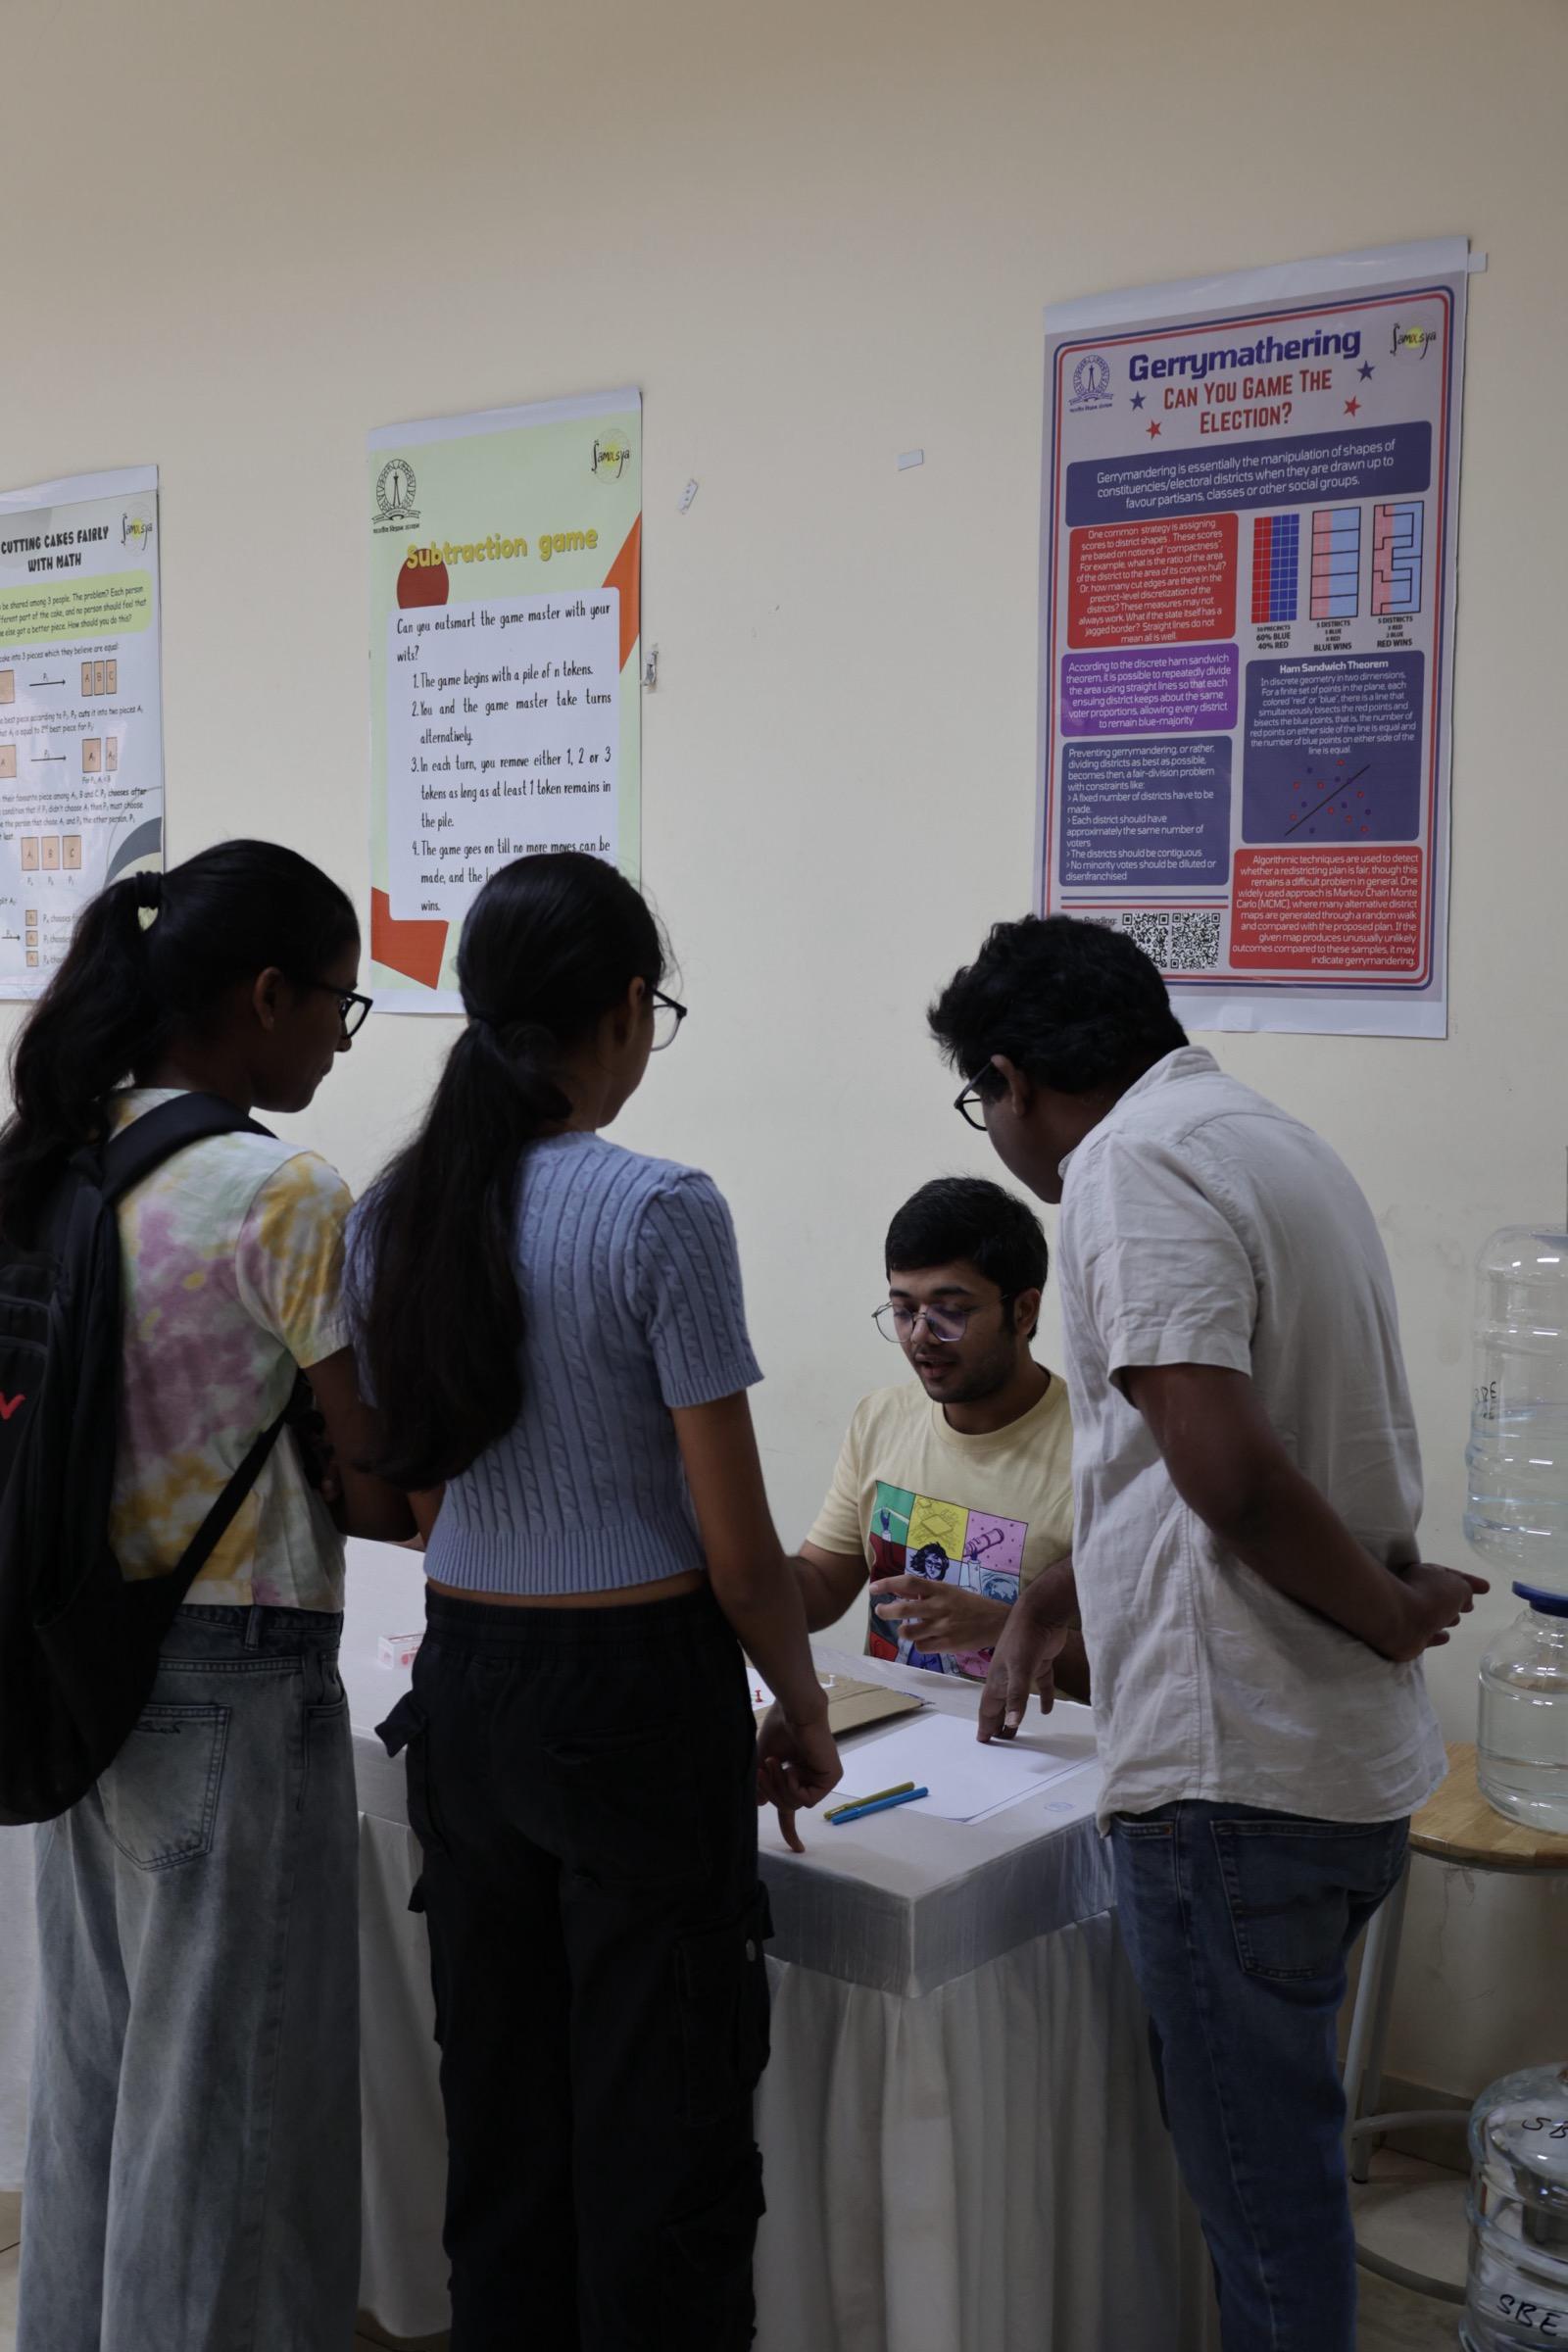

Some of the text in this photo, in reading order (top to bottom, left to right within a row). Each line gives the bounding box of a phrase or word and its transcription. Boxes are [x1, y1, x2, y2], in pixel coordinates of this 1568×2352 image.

[1130, 330, 1360, 381] Gerrymathering
[1164, 369, 1332, 410] CAN YOU GAME THE
[1200, 402, 1293, 434] ELECTION?
[1098, 439, 1396, 484] Gerrymandering is essentially the manipulation of shapes of
[1098, 457, 1394, 497] constituencies/electoral districts when they are drawn up to
[1126, 498, 1156, 508] favour
[1158, 493, 1204, 508] partisans,
[1207, 489, 1245, 500] classes
[1259, 482, 1286, 494] other
[1289, 478, 1318, 491] social
[1320, 477, 1360, 491] groups.
[1, 526, 109, 554] CUTTING CAKES FAIRLY
[406, 528, 598, 569] Subtraction game
[28, 553, 81, 572] WITH MATH
[397, 601, 611, 636] Can you outsmart the game master with your
[397, 645, 419, 662] wits?
[1394, 638, 1412, 647] WINS
[1069, 653, 1229, 672] According to the discrete ham sandwich
[1280, 661, 1389, 673] Ham Sandwich Theorem
[420, 672, 435, 687] The
[438, 675, 461, 691] game
[464, 669, 489, 688] begins
[492, 666, 512, 682] with
[514, 670, 519, 680] a
[523, 664, 539, 684] pile
[542, 662, 552, 677] of
[555, 667, 560, 677] n
[563, 662, 593, 676] tokens.
[420, 702, 432, 715] You
[440, 700, 455, 714] and
[464, 698, 478, 712] the
[485, 701, 509, 716] game
[516, 694, 548, 709] master
[557, 691, 577, 706] take
[587, 691, 612, 704] turns
[420, 726, 473, 745] alternatively.
[421, 758, 428, 771] In
[432, 756, 451, 771] each
[456, 757, 476, 770] turn,
[481, 759, 495, 773] you
[501, 758, 529, 767] remove
[534, 751, 562, 765] either
[578, 749, 584, 763] 2
[590, 754, 599, 762] or
[605, 746, 611, 762] 3
[1069, 749, 1110, 760] Preventing
[1112, 746, 1178, 760] gerrymandering,
[1190, 745, 1214, 754] rather,
[421, 778, 611, 802] tokens as long as at least 1 token remains in
[421, 812, 454, 832] the pile.
[421, 841, 437, 856] The
[440, 845, 461, 860] game
[465, 844, 481, 859] goes
[484, 844, 494, 853] on
[498, 838, 510, 853] till
[514, 843, 523, 852] no
[526, 842, 548, 852] more
[579, 842, 596, 851] can
[600, 836, 610, 851] be
[1253, 855, 1298, 865] Algorithmic
[1300, 855, 1345, 865] techniques
[1393, 854, 1418, 862] detect
[421, 867, 446, 884] made,
[449, 867, 465, 882] and
[468, 867, 482, 882] the
[421, 901, 441, 911] wins.
[1346, 956, 1415, 967] gerrymandering.
[1496, 2294, 1561, 2336] SBE
